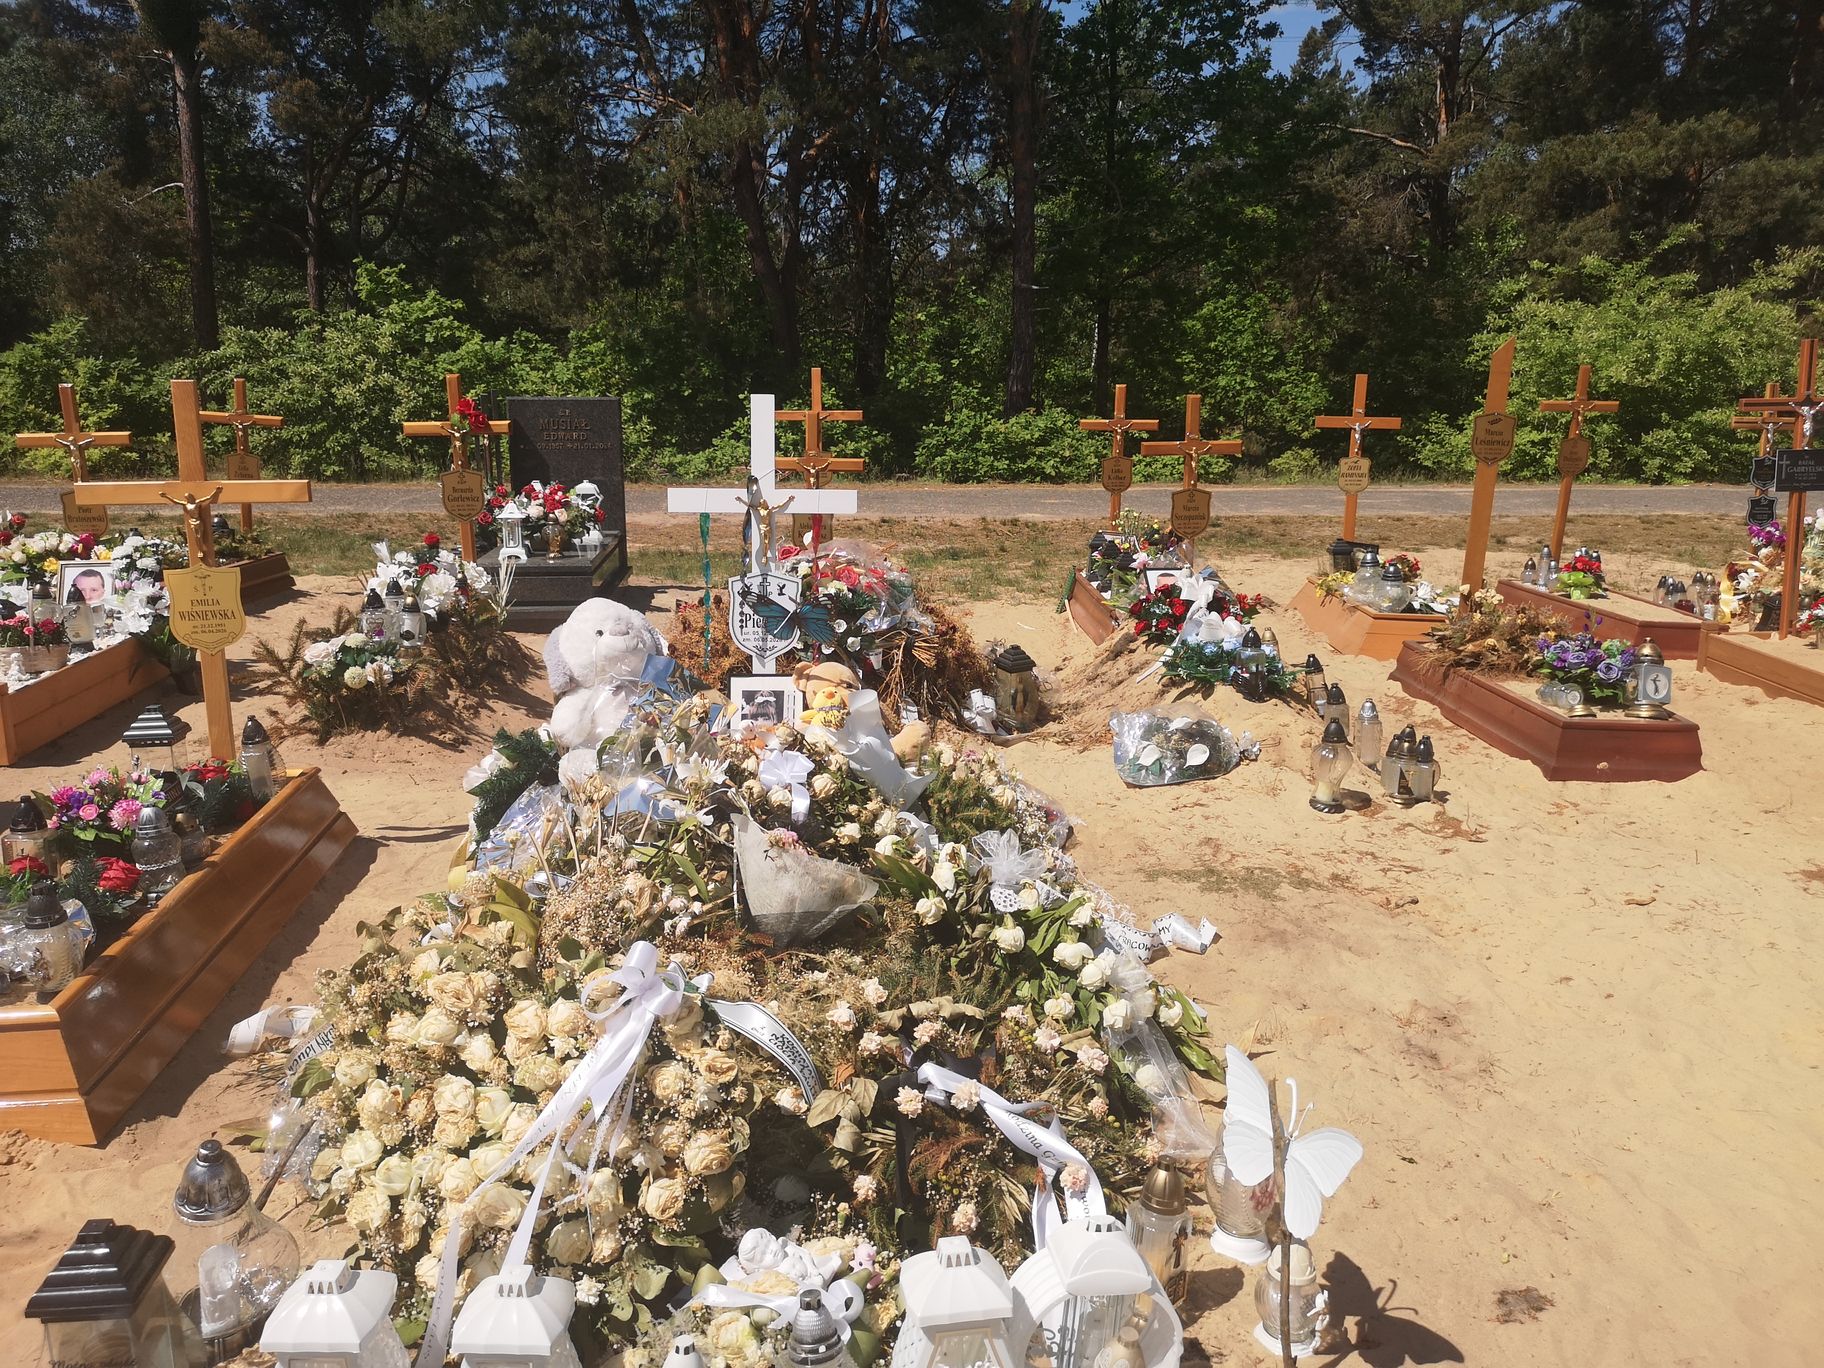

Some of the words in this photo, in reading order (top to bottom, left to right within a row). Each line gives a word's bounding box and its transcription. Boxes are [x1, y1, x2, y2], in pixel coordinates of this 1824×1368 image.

[540, 418, 591, 430] MUSIAŁ
[543, 432, 588, 441] EDWARD
[190, 599, 221, 607] EMILIA
[178, 608, 236, 621] WIŚNIEWSKA
